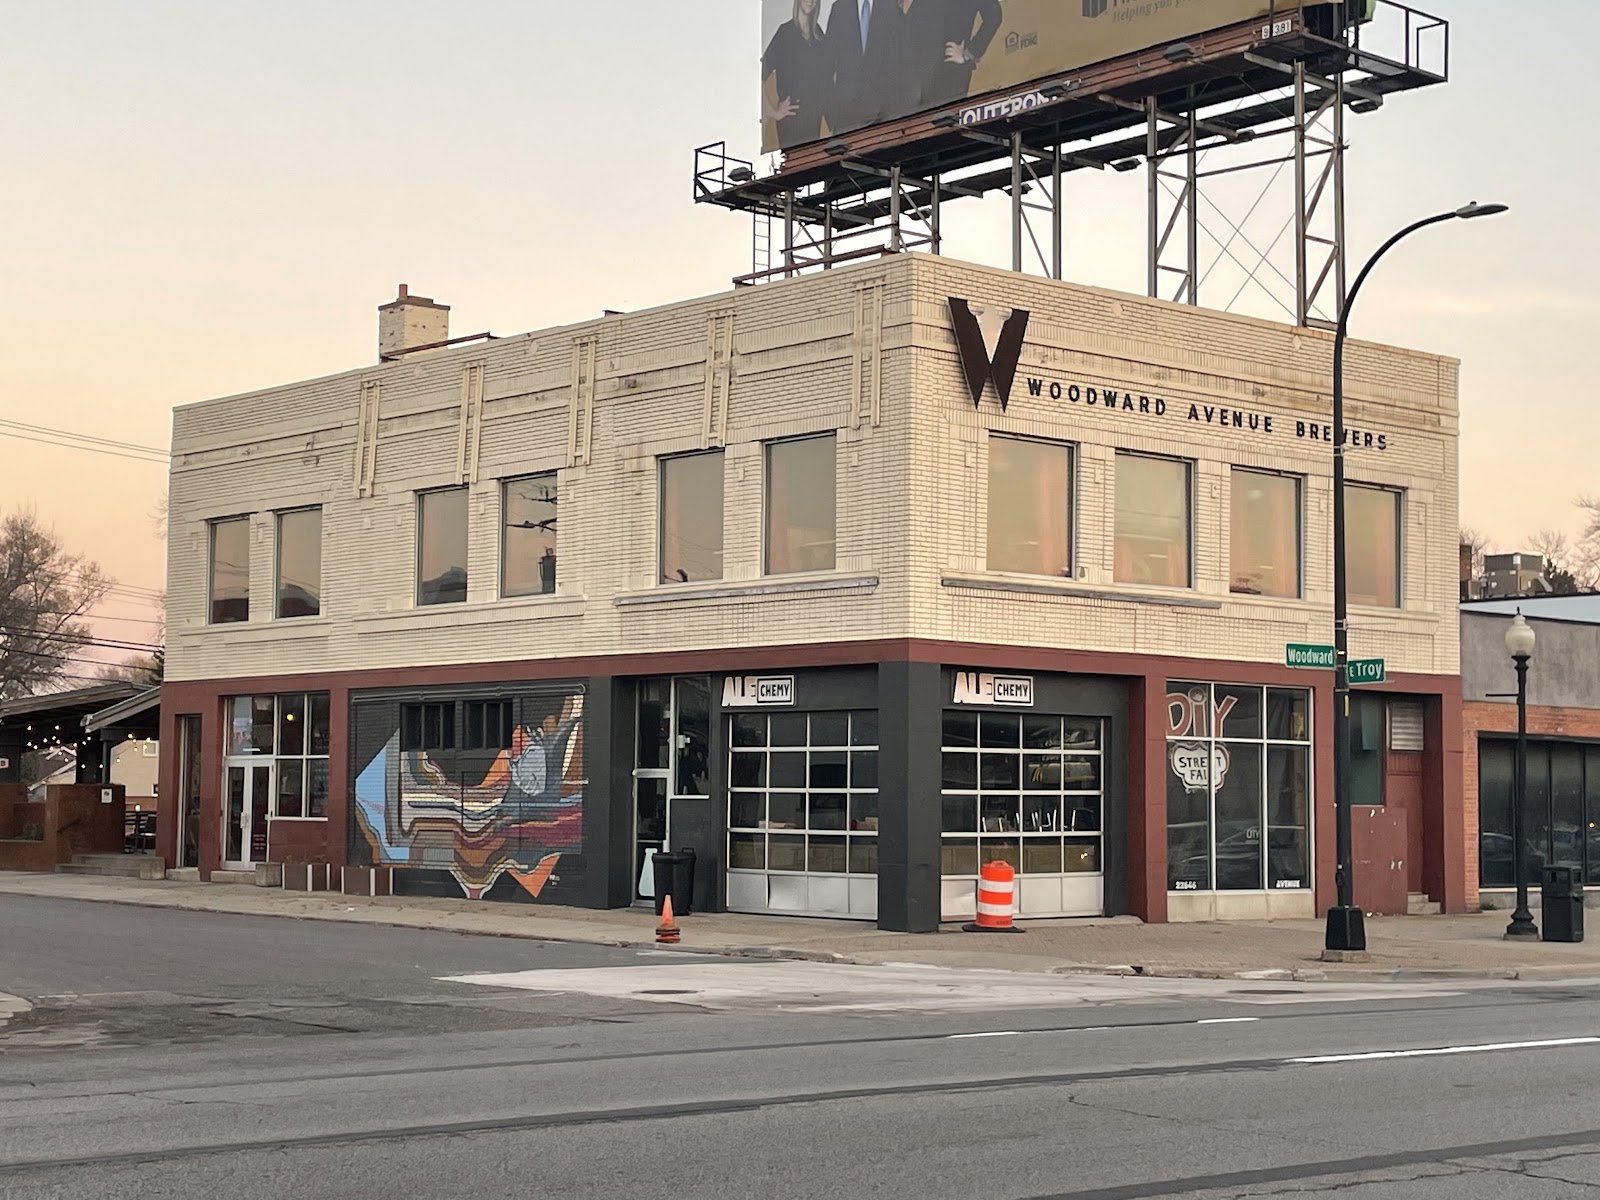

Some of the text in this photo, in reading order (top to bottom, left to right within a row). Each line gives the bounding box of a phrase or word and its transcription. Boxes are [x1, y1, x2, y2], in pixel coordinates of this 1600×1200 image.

[1112, 3, 1152, 23] Helping
[947, 296, 1030, 413] W
[1026, 377, 1167, 416] WOODWARD
[1187, 403, 1273, 433] AVENUE
[1287, 648, 1333, 665] Woodward
[1349, 662, 1382, 680] E Troy
[760, 684, 790, 697] CHEMY
[997, 682, 1029, 697] CHEMY
[1178, 756, 1222, 768] STRET
[1190, 769, 1218, 781] FAI
